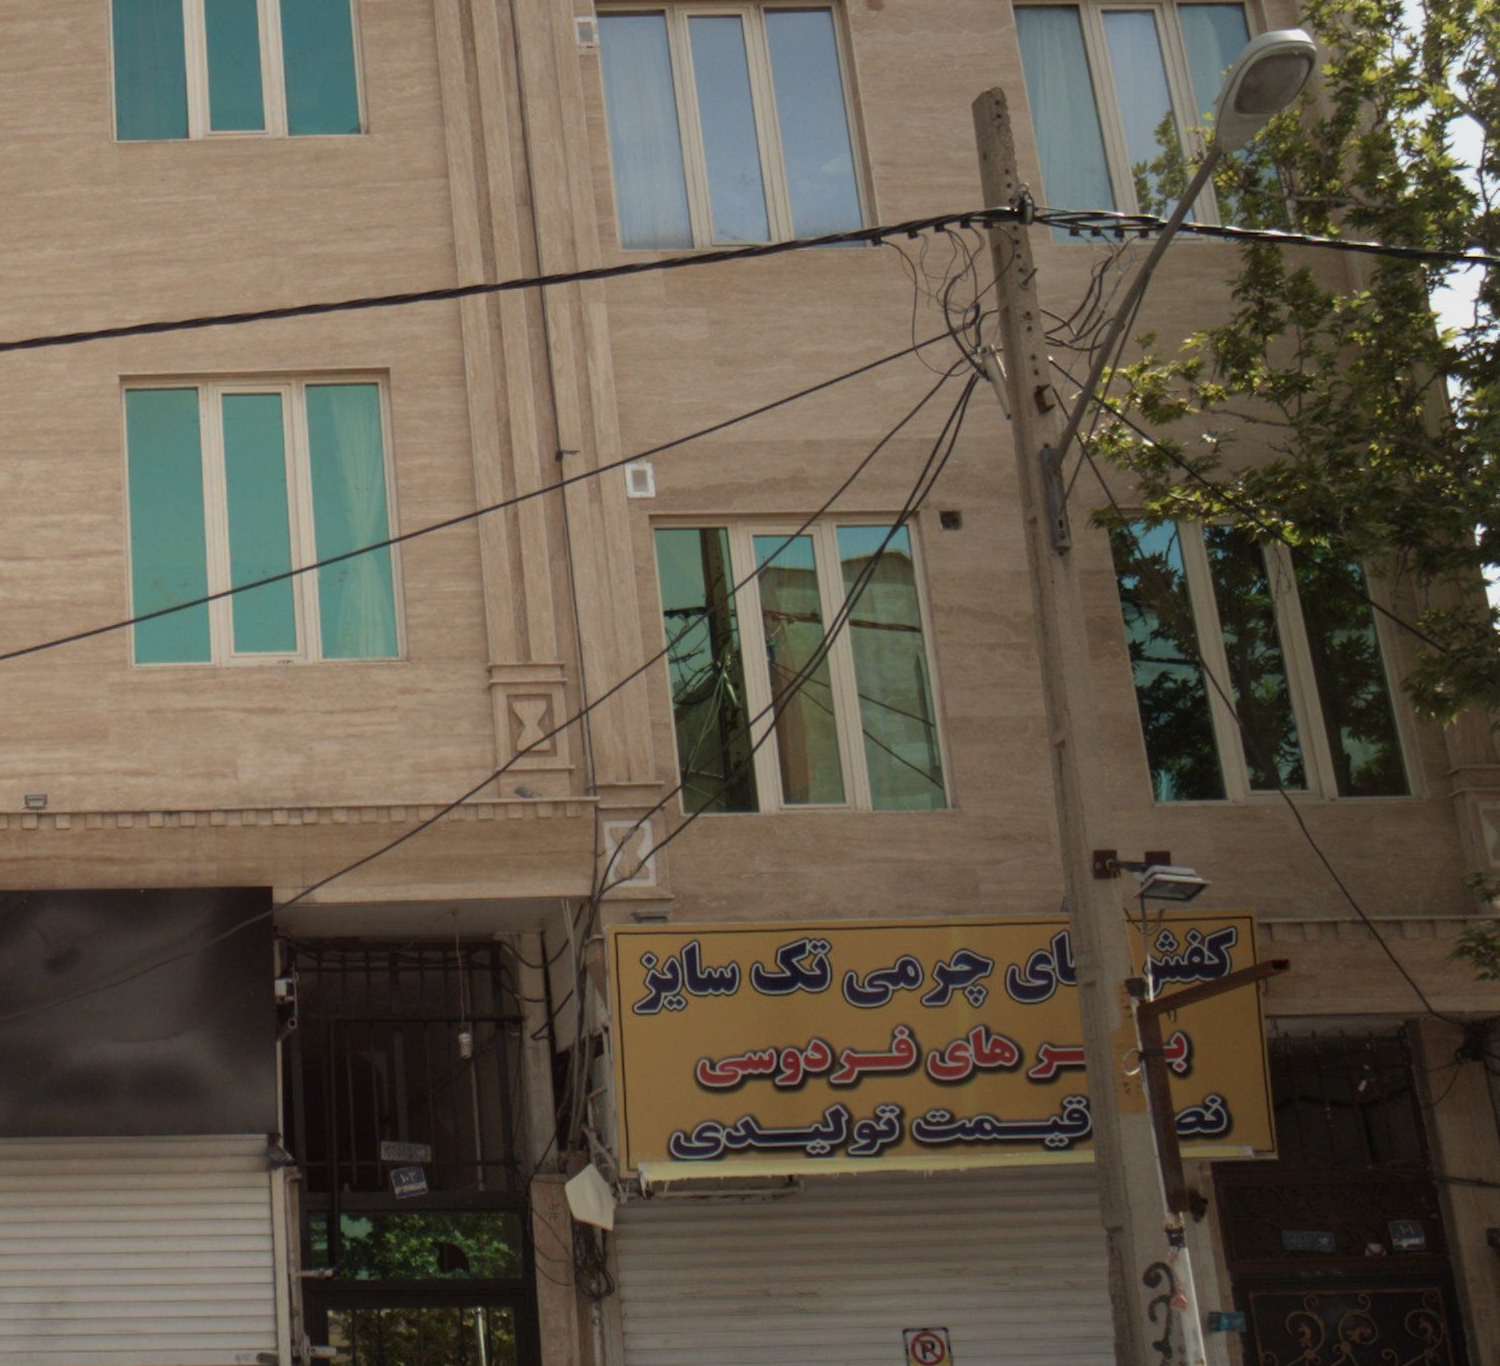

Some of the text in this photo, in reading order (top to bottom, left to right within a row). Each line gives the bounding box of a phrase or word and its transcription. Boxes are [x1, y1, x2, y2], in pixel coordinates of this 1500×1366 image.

[633, 927, 1237, 1014] کفش ای چرمی تک سایز
[697, 1025, 917, 1086] فردوسی
[927, 1025, 1019, 1080] های
[670, 1104, 899, 1160] تولیدی
[911, 1095, 1092, 1147] قیمت
